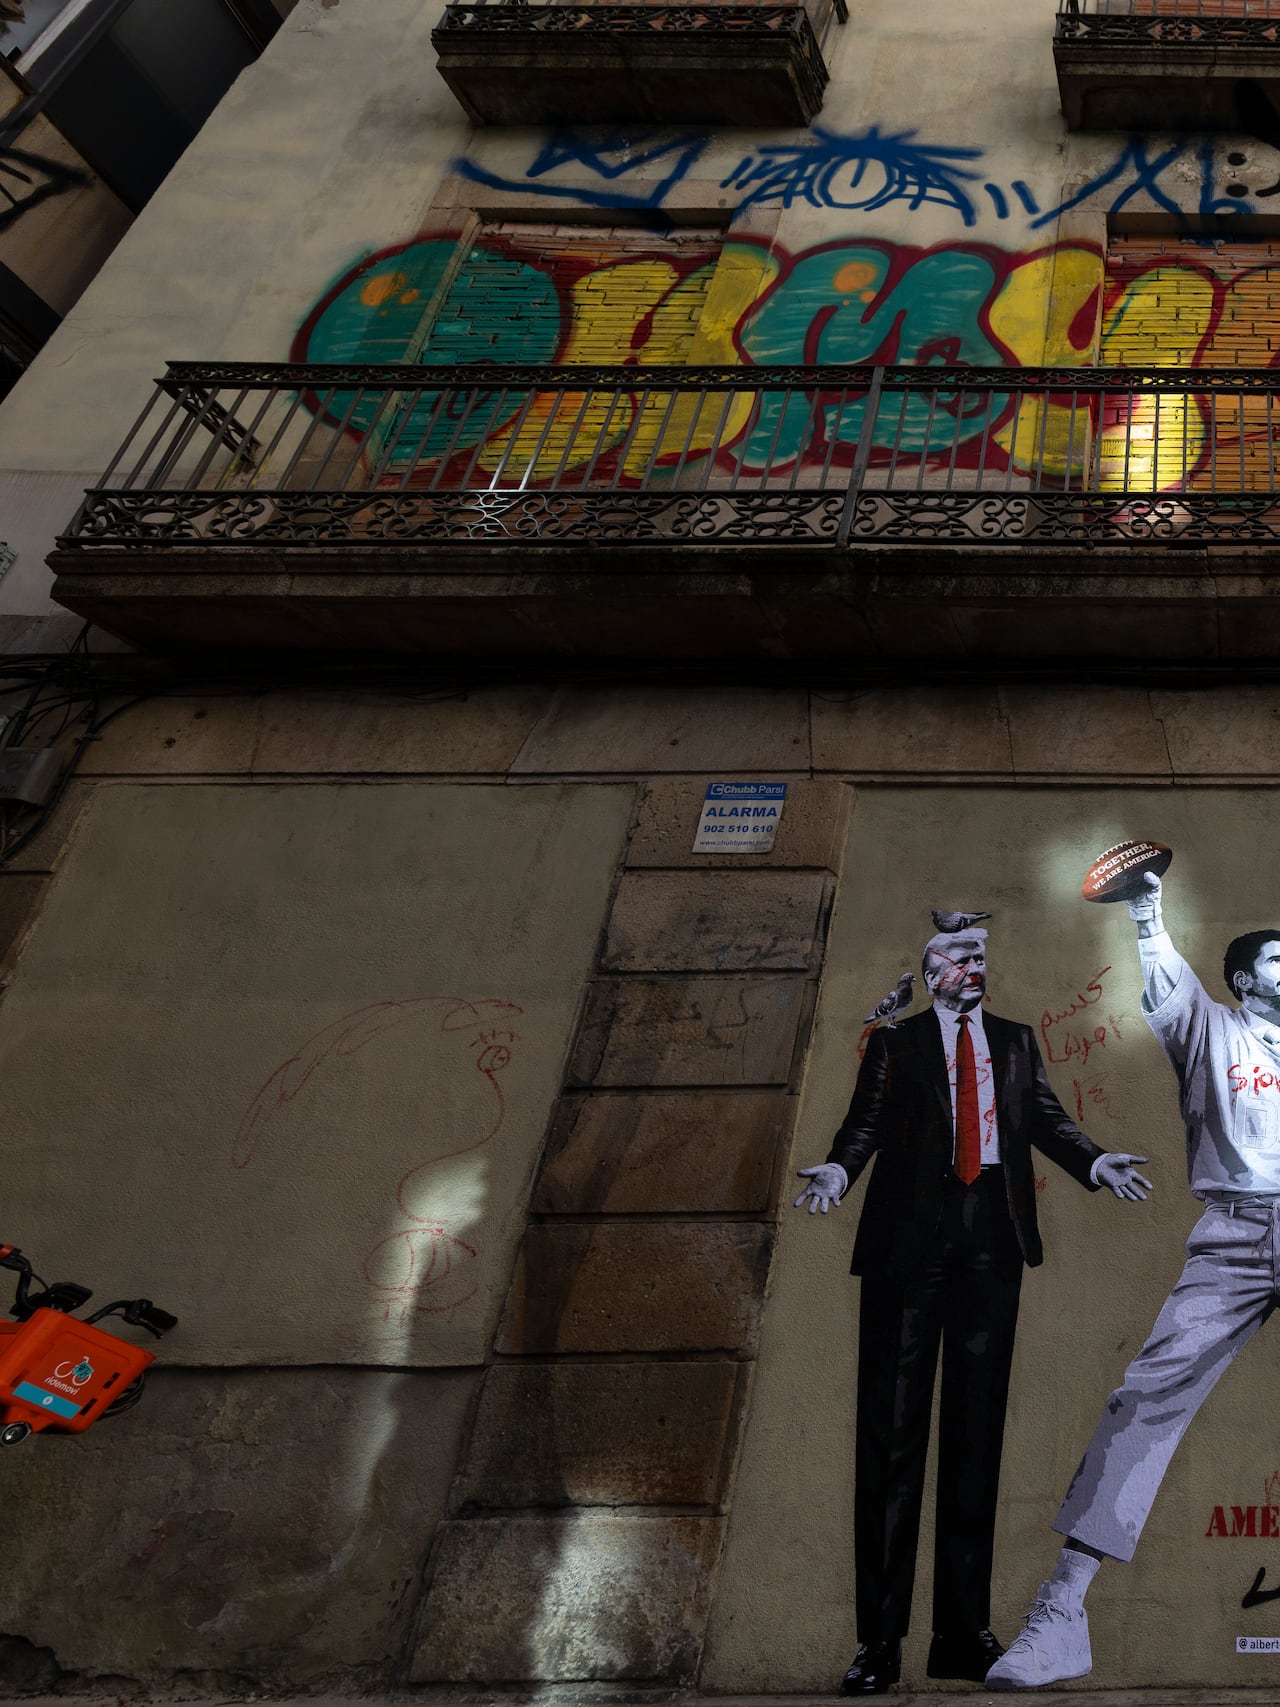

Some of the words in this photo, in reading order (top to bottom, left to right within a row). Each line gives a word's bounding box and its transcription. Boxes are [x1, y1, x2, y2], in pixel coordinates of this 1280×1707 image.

[724, 785, 757, 794] Chubb
[758, 785, 785, 794] Parsi
[705, 807, 777, 817] ALARMA
[703, 825, 725, 833] 902
[728, 825, 749, 833] 510
[752, 825, 773, 833] 610
[1090, 843, 1153, 879] TOGETHER,
[1092, 880, 1107, 891] WE
[1106, 866, 1123, 880] ARE
[1123, 849, 1162, 870] AMERICA
[43, 1376, 80, 1396] ridemovi
